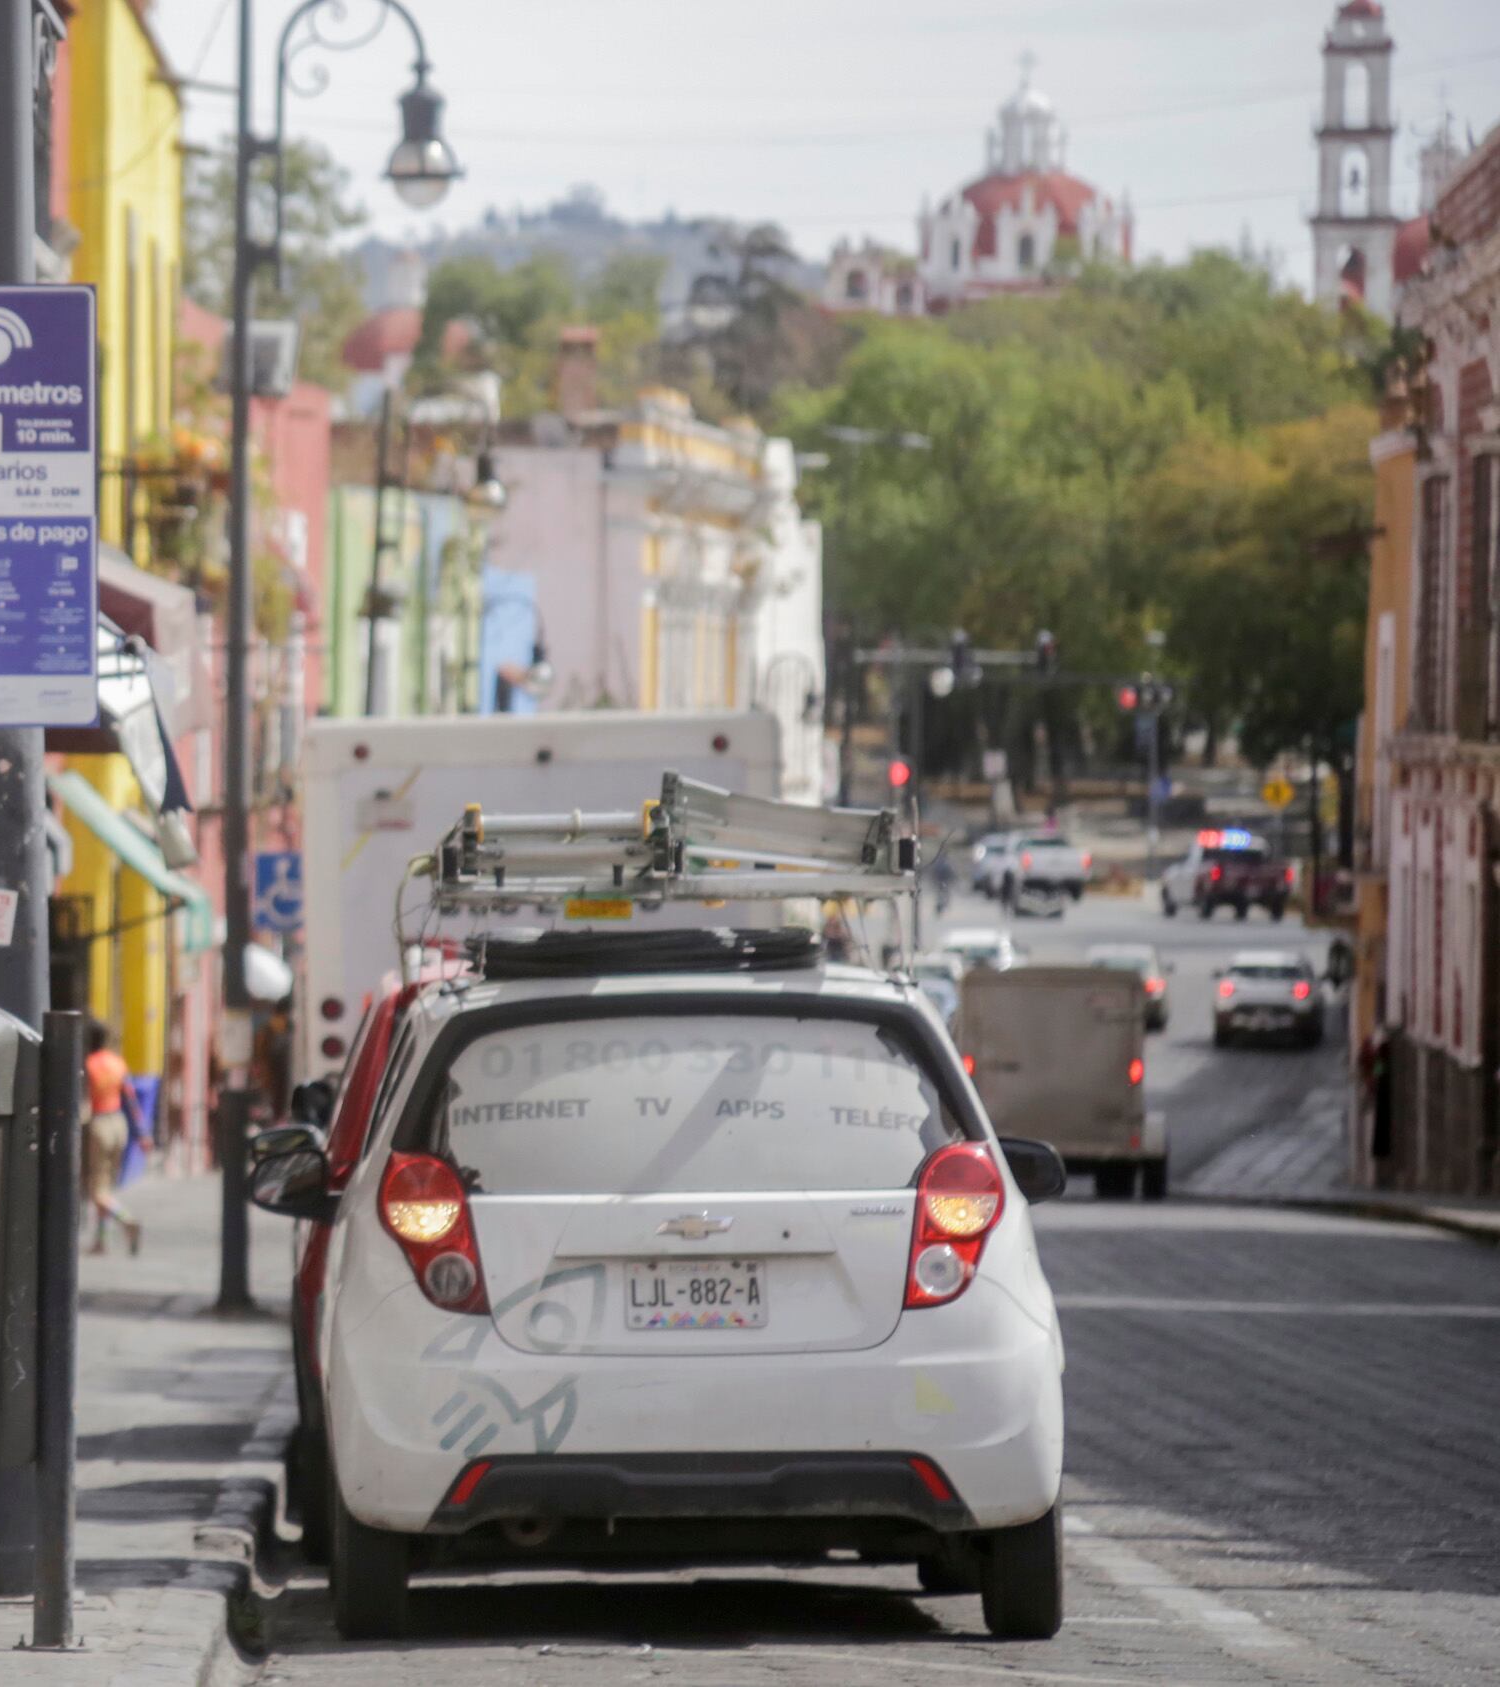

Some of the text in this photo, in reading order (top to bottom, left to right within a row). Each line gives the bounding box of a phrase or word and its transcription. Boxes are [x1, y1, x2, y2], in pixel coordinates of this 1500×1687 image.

[16, 428, 75, 443] 10 min.
[10, 523, 35, 541] de
[39, 527, 88, 546] pago
[453, 1099, 590, 1126] INTERNET
[635, 1097, 671, 1116] TV
[716, 1099, 785, 1119] APPS
[631, 1277, 760, 1307] LJL-882-A
